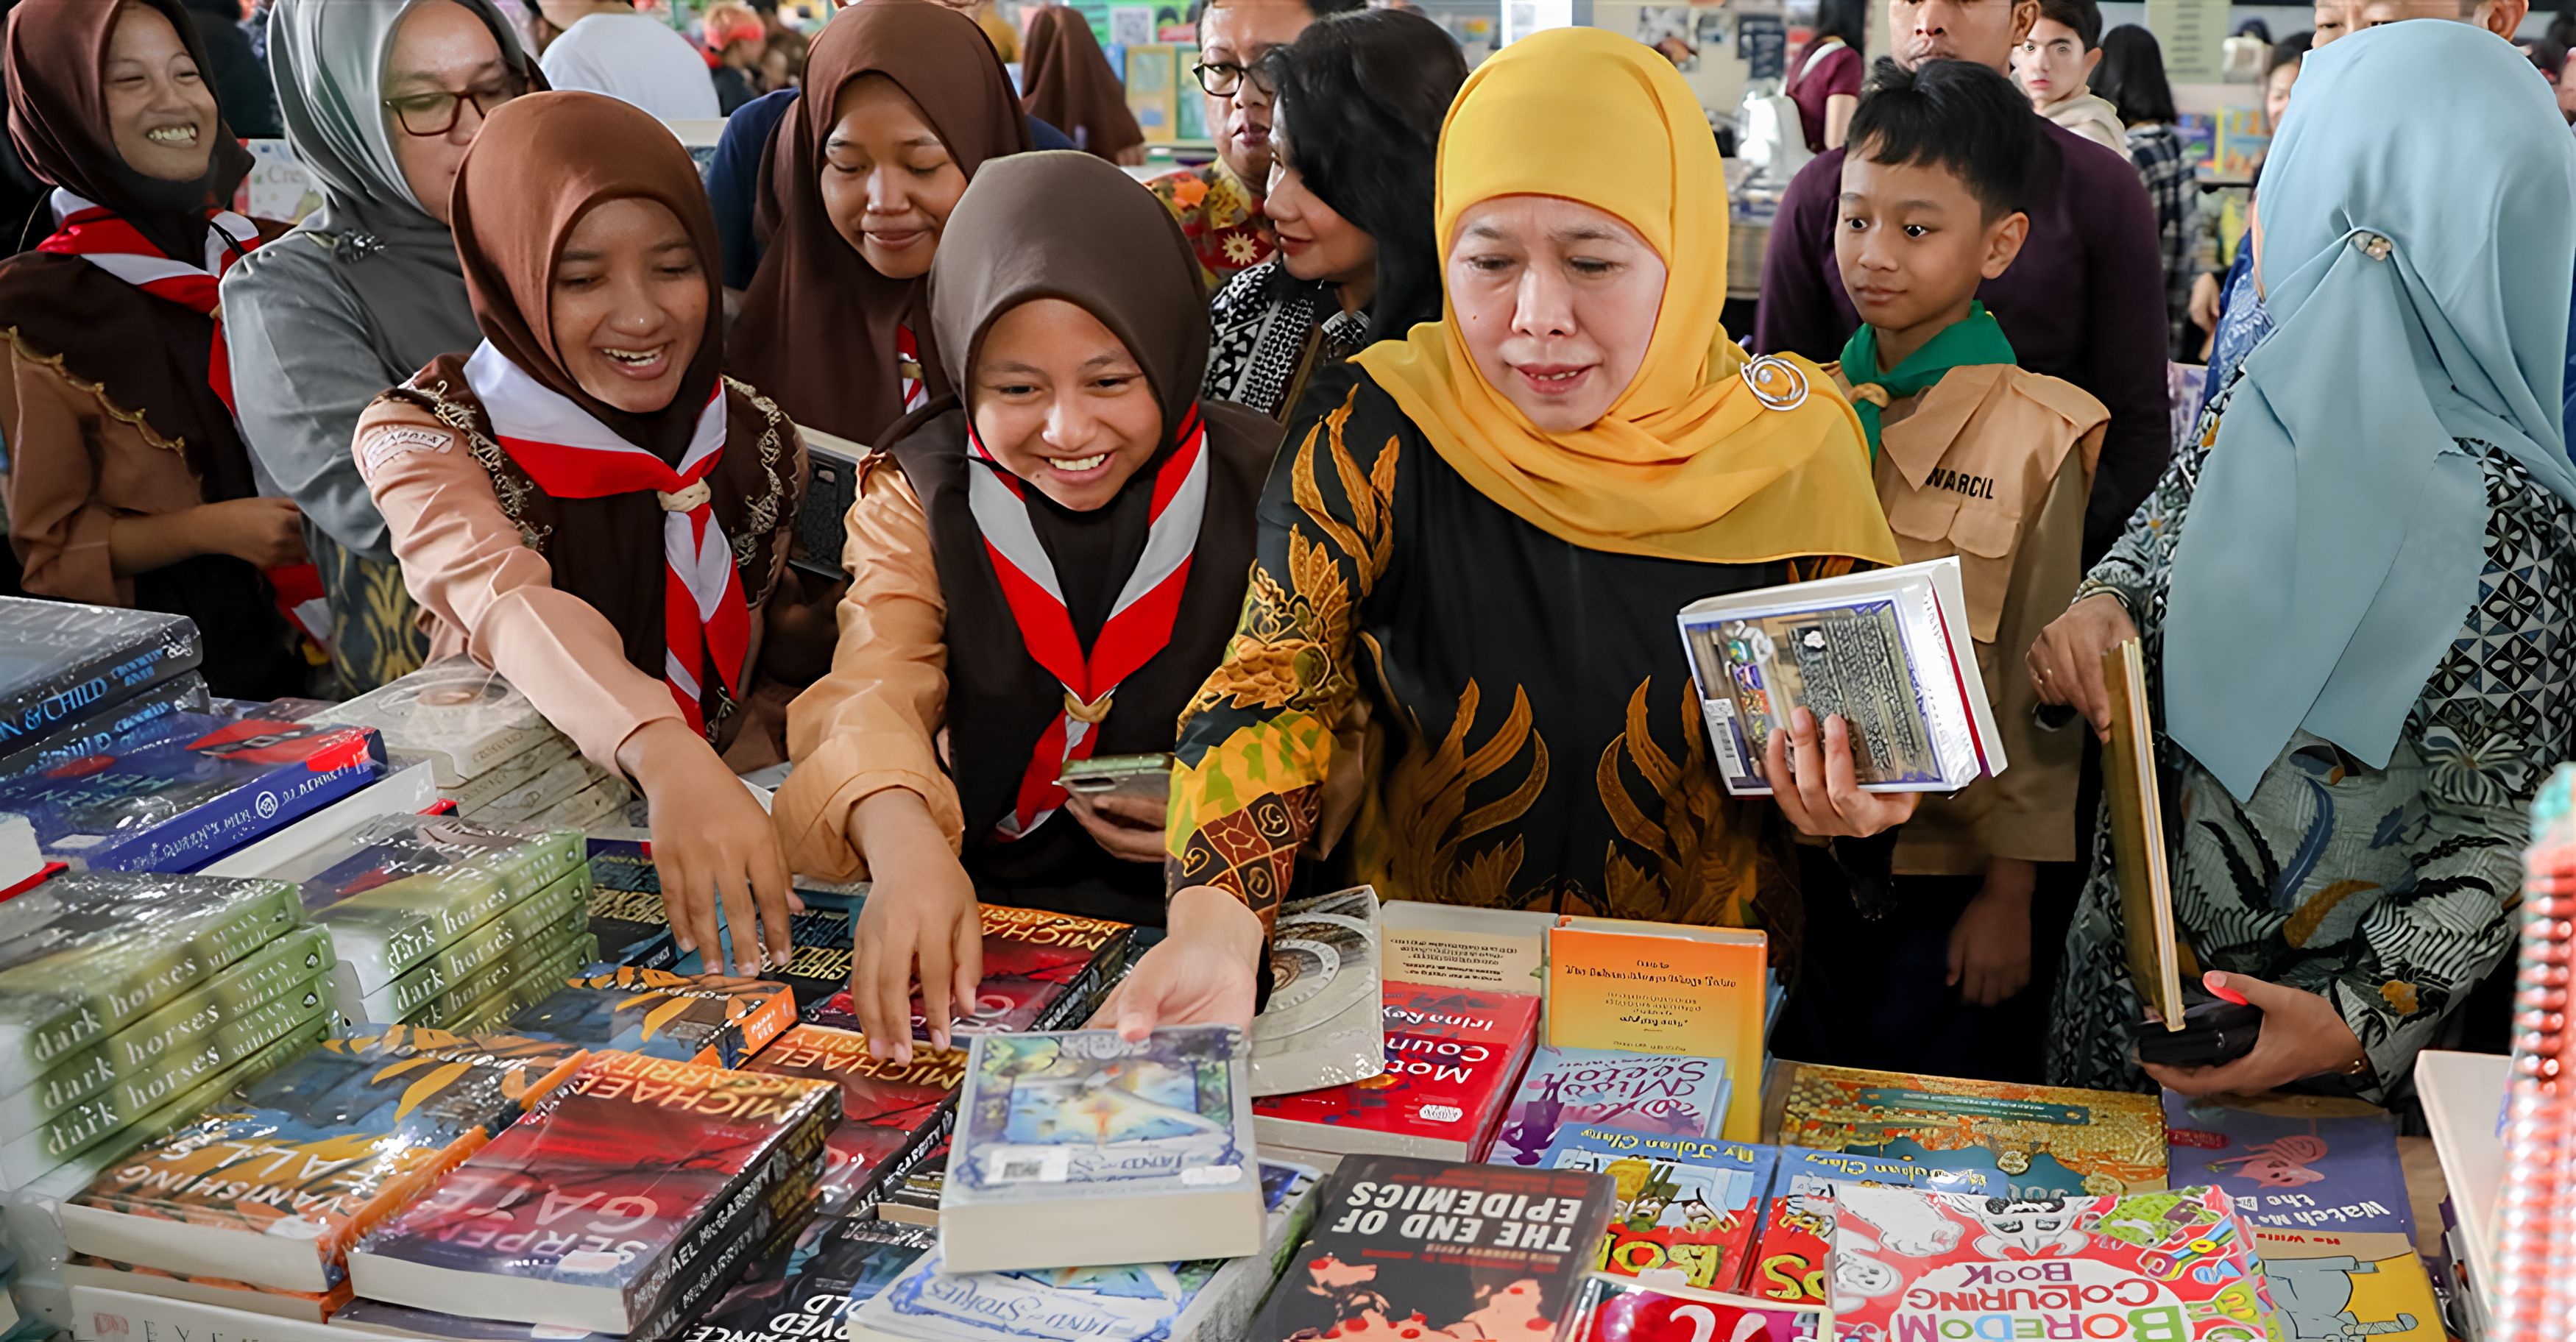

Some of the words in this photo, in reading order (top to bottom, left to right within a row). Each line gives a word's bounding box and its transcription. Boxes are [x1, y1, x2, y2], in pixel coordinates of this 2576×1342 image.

[42, 676, 108, 721] CHILD
[441, 887, 509, 934] horses
[982, 920, 1106, 951] MICHA
[397, 967, 445, 1012] dark
[450, 920, 514, 978] horses
[34, 1007, 102, 1063] dark
[107, 958, 198, 1018] horses
[43, 1056, 116, 1111] dark
[124, 1004, 220, 1067] horses
[770, 1045, 965, 1090] MICHAEL
[1385, 1037, 1489, 1062] Coun
[127, 1042, 220, 1110] horses
[1384, 1059, 1472, 1084] Mot
[116, 1165, 342, 1213] VANISHING
[1345, 1181, 1582, 1224] EPIDEMICS
[1331, 1208, 1388, 1235] OF
[1400, 1213, 1482, 1242] END
[2294, 1201, 2391, 1226] Watch
[434, 1221, 648, 1265] SERPEN
[1493, 1221, 1571, 1252] THE
[1906, 1278, 2158, 1311] COLOURING
